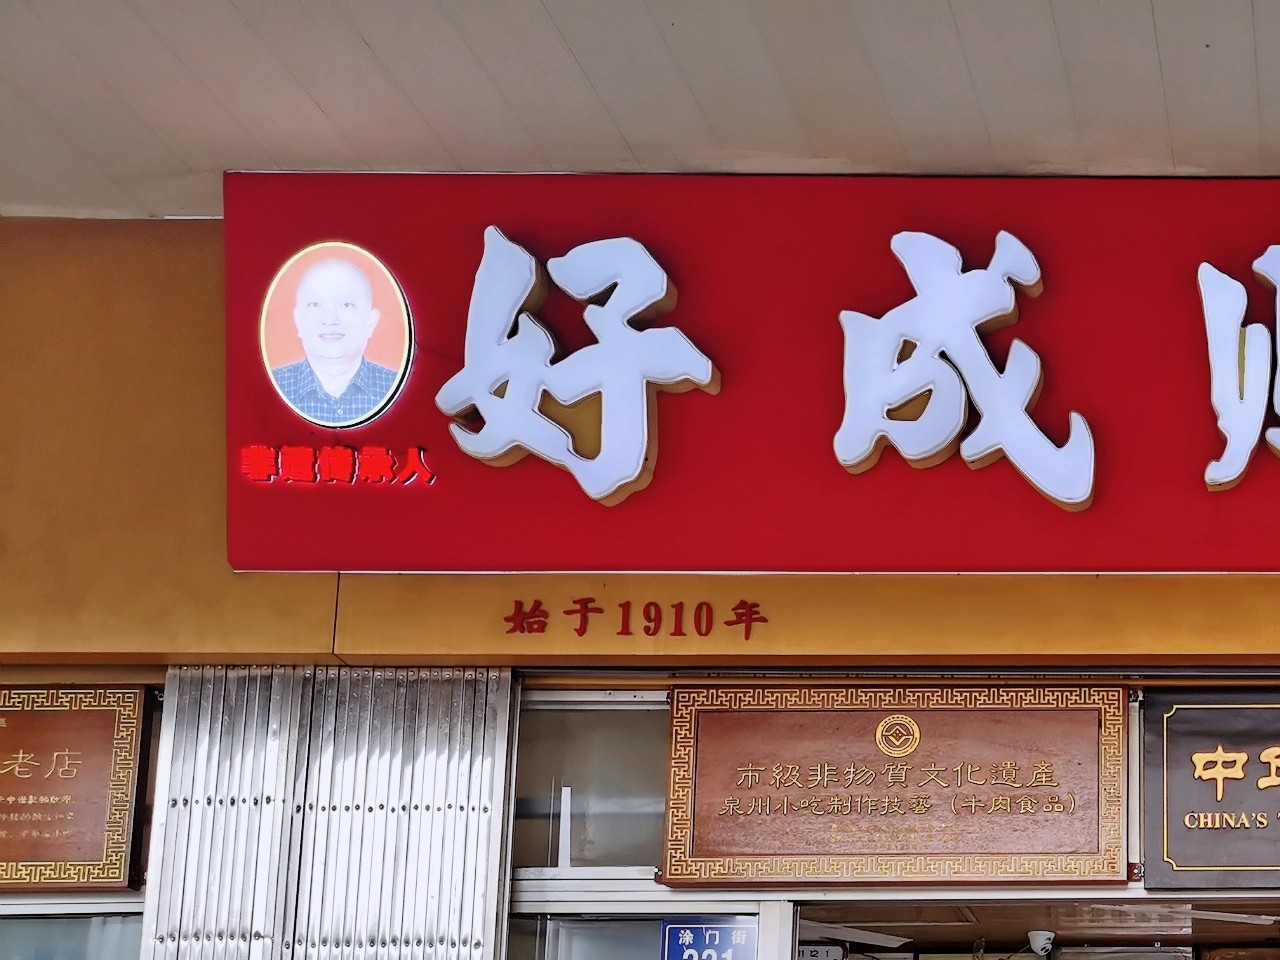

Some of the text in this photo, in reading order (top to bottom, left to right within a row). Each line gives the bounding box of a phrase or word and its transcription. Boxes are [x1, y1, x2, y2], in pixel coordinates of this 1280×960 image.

[504, 597, 768, 641] 始于1910年
[0, 749, 83, 779] 老店
[678, 930, 746, 945] 涂门街
